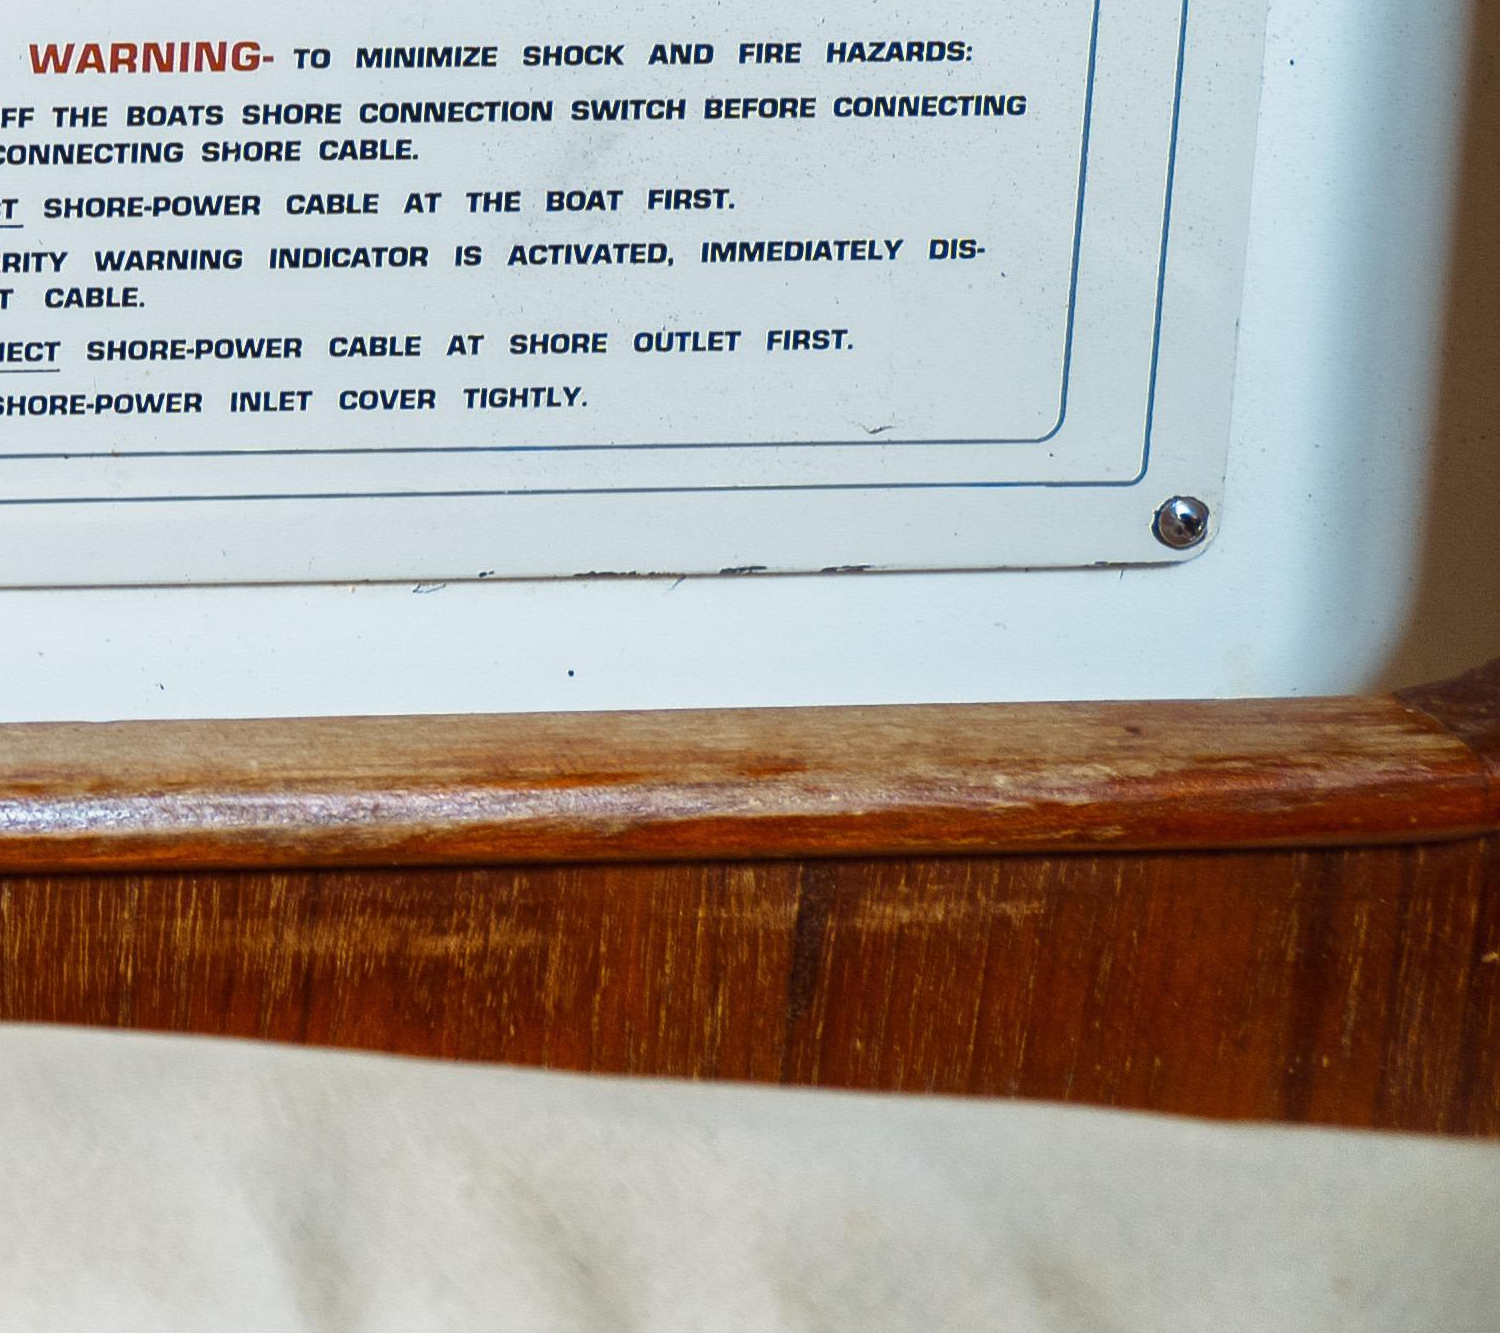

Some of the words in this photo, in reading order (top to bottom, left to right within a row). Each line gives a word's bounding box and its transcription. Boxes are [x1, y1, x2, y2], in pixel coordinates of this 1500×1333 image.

[29, 41, 275, 74] WARNING-
[293, 48, 331, 69] TO
[355, 46, 498, 69] MINIMIZE
[522, 44, 625, 67] SHOCK
[648, 42, 714, 65] AND
[738, 42, 802, 64] FIRE
[826, 40, 973, 64] HAZARDS:
[52, 106, 108, 128] THE
[126, 105, 224, 127] BOATS
[242, 103, 342, 126] SHORE
[359, 100, 553, 124] CONNECTION
[571, 98, 686, 121] SWITCH
[704, 97, 817, 120] BEFORE
[833, 94, 1027, 118] CONNECTING
